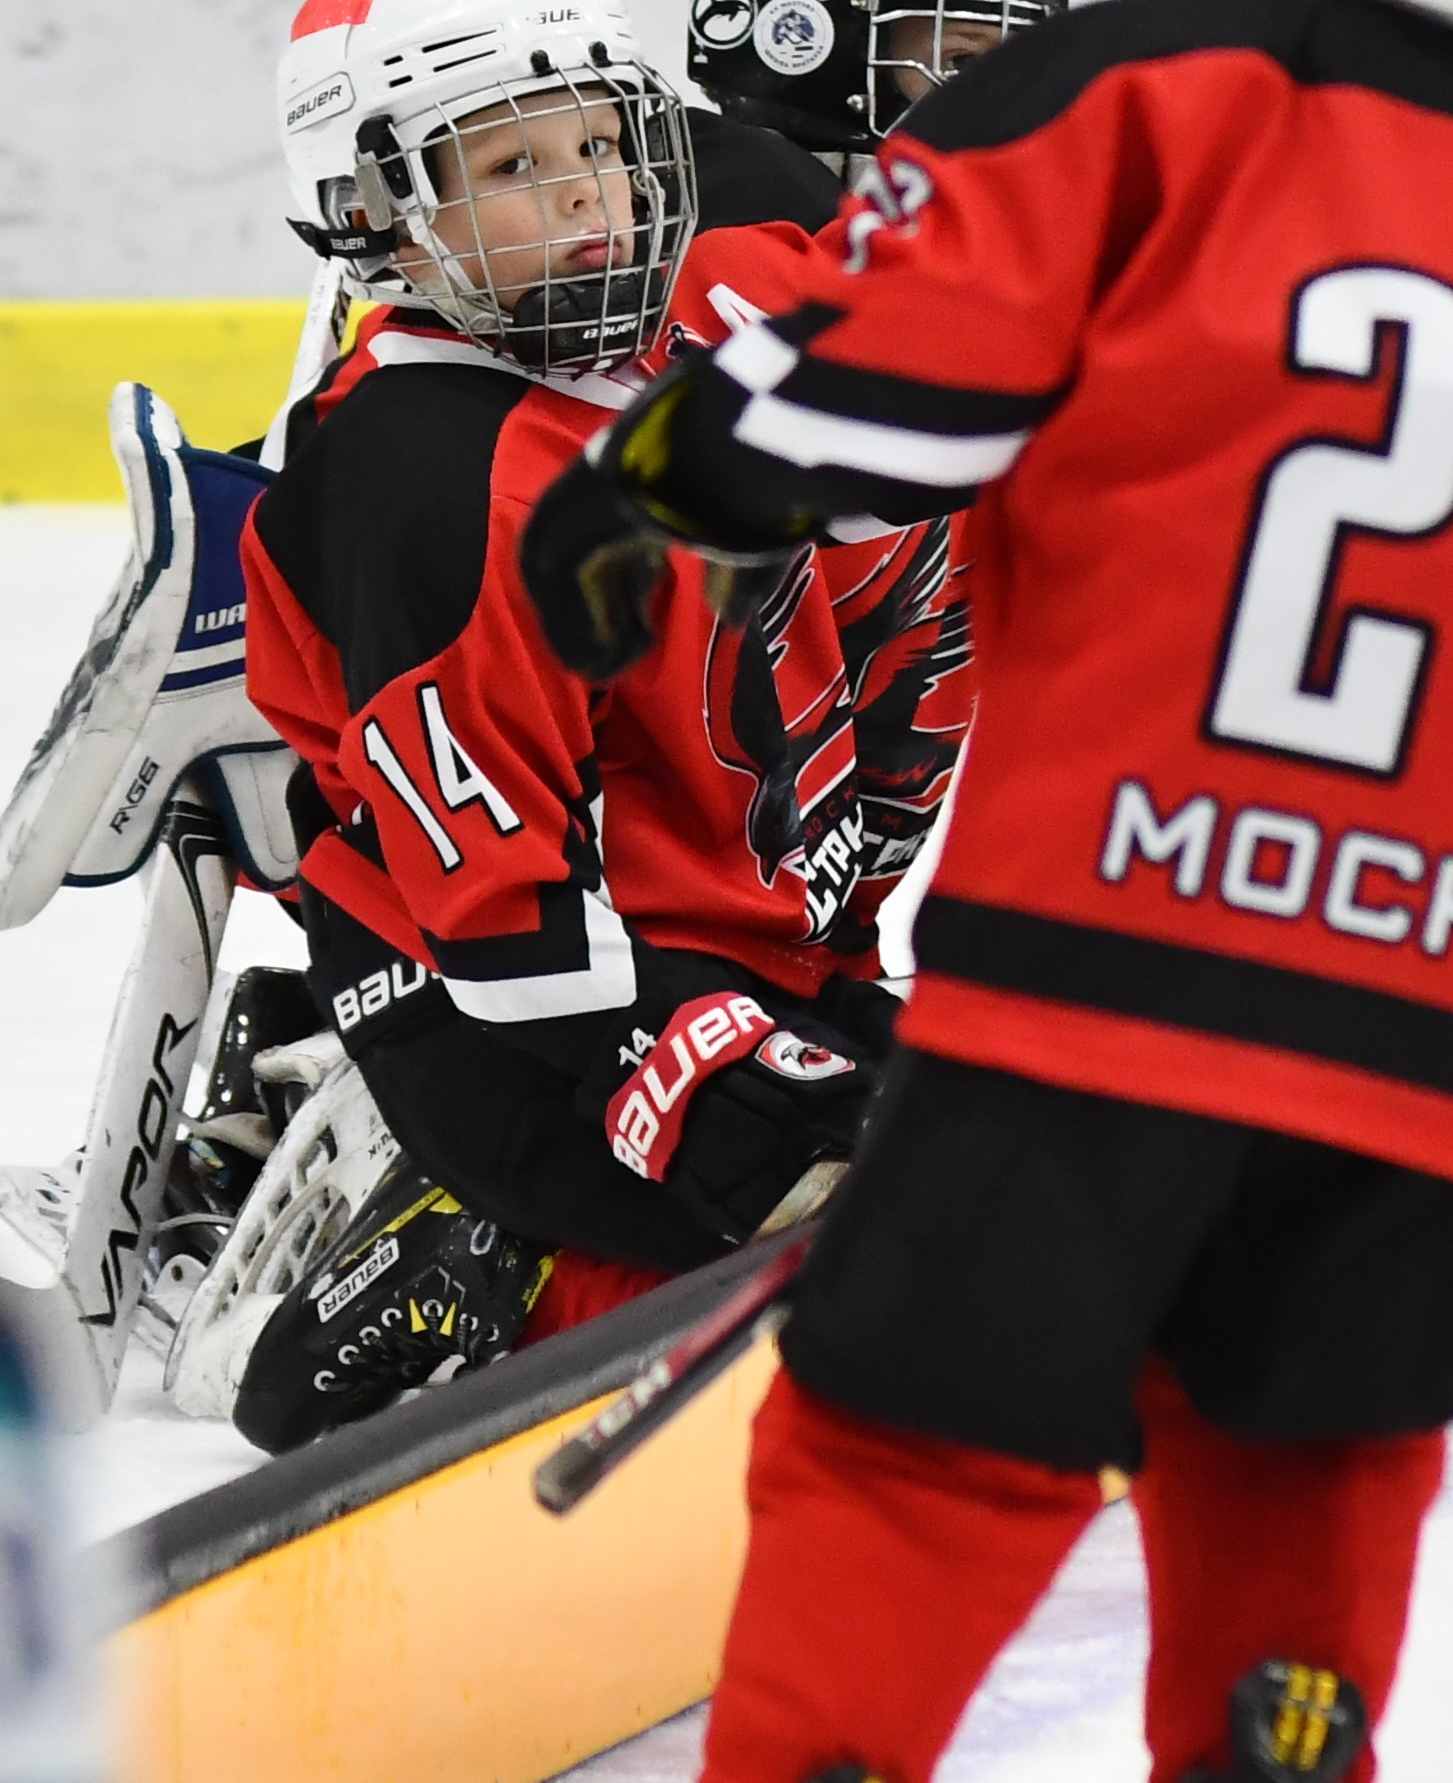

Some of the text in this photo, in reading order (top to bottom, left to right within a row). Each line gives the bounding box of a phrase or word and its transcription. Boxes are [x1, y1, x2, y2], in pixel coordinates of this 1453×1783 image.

[286, 84, 342, 127] BAUER
[362, 680, 523, 875] 14
[612, 996, 775, 1180] BAUER
[323, 1245, 394, 1314] BAUER
